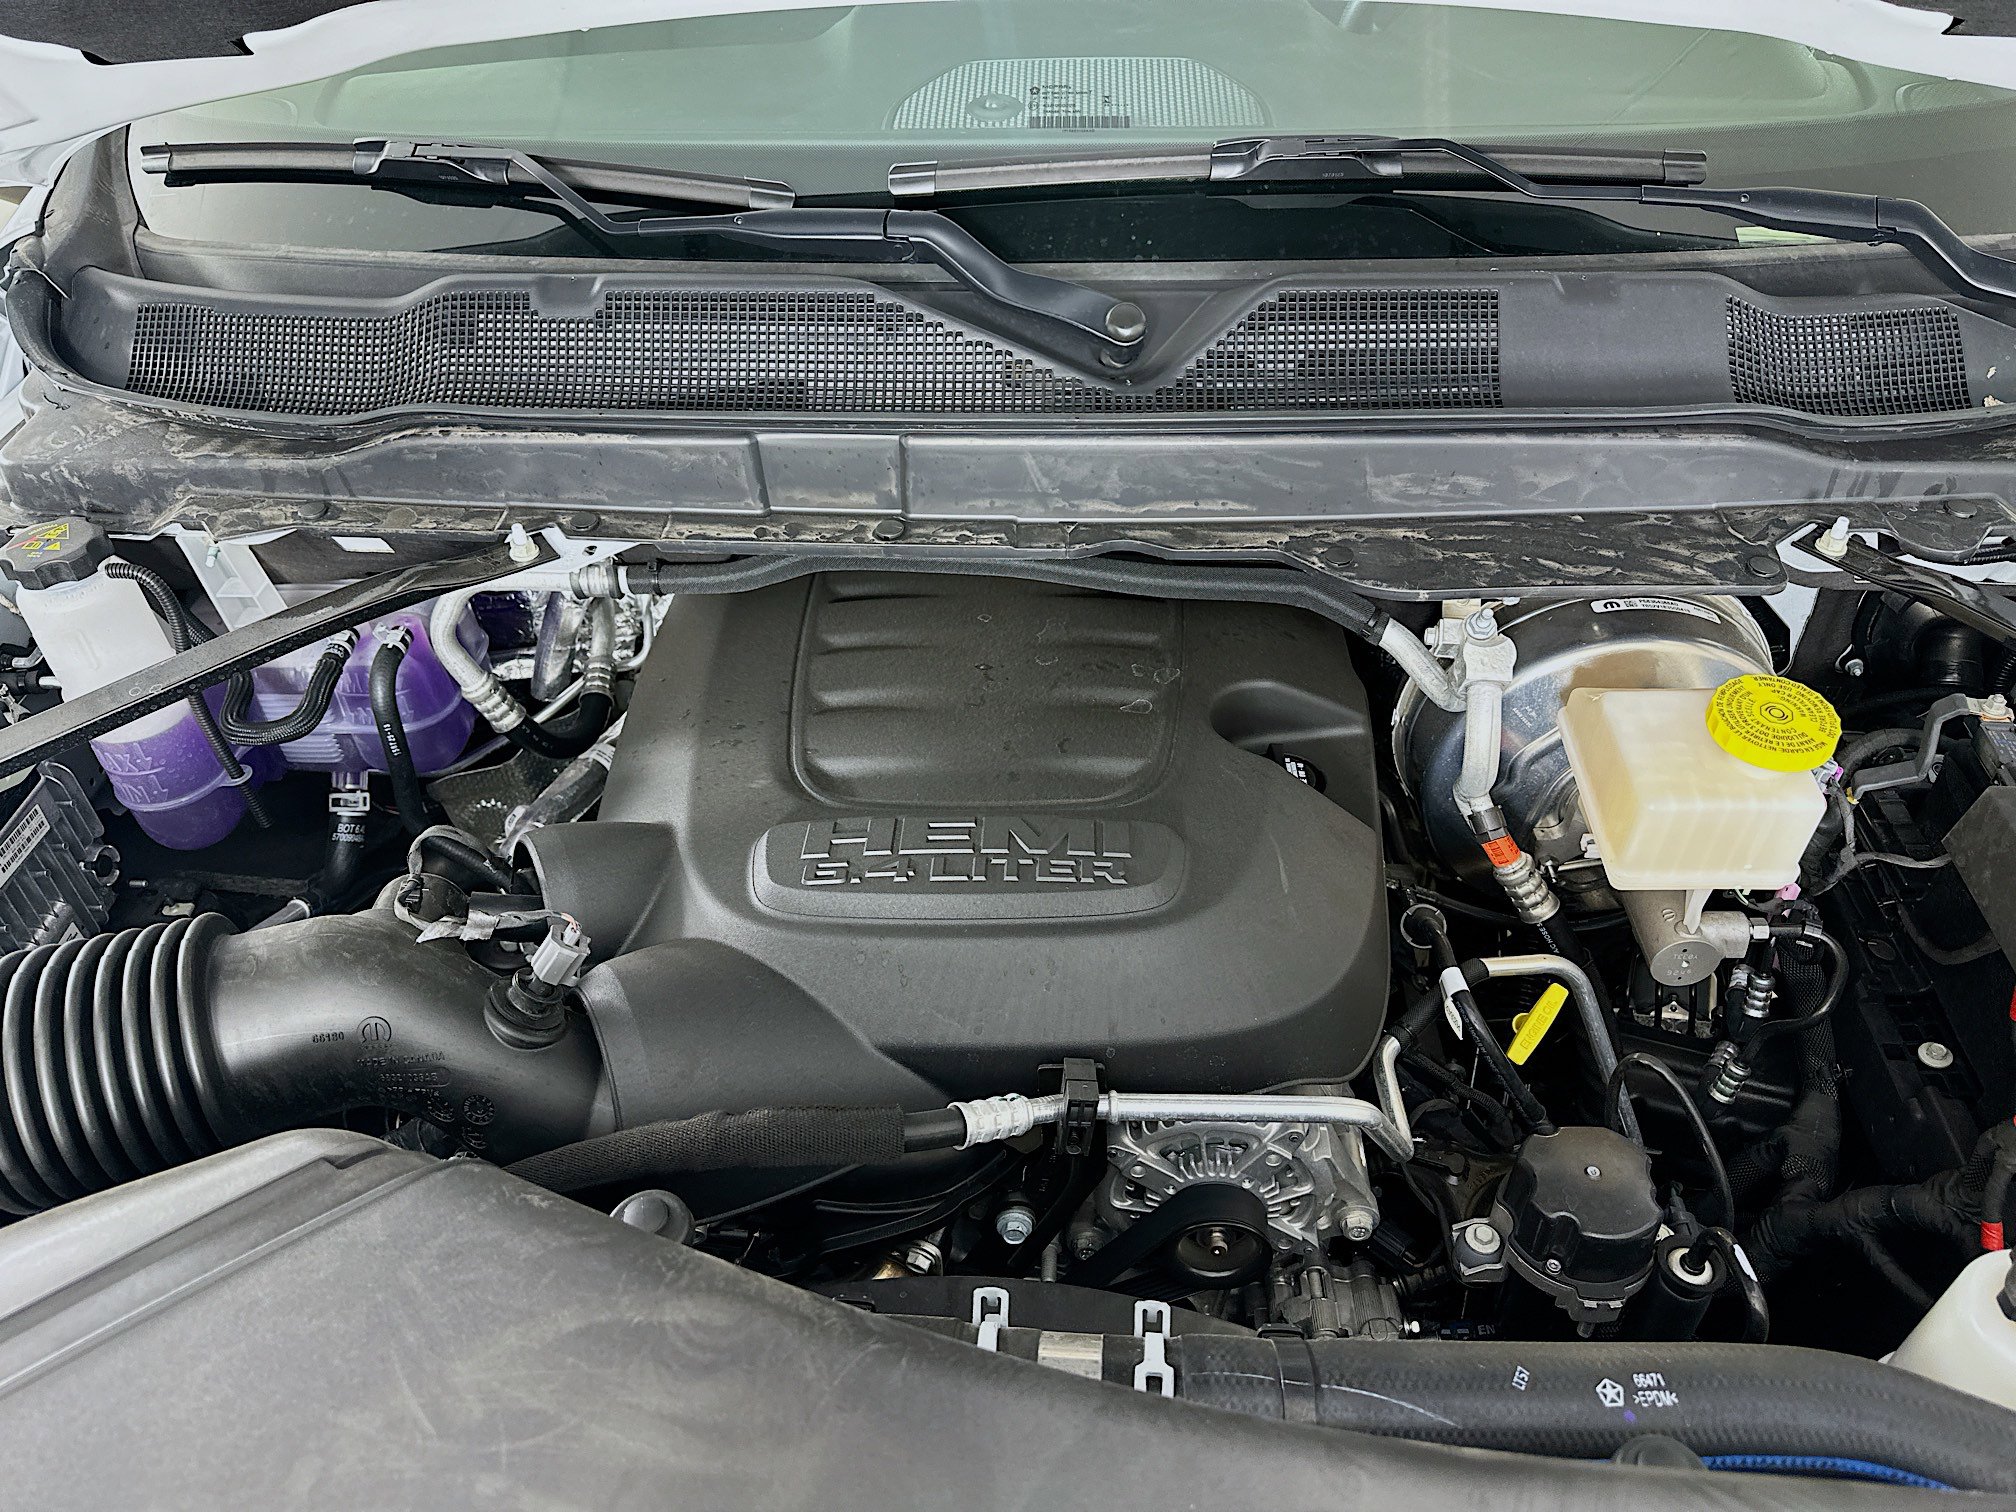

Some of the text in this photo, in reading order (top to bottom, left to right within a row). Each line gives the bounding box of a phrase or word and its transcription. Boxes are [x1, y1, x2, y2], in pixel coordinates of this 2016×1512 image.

[337, 823, 356, 834] BOT
[800, 816, 1132, 859] HEMI
[801, 856, 1128, 886] 6.4 LITER
[1538, 926, 1554, 944] HOSE
[1519, 1000, 1558, 1050] ENGINE OIL
[1632, 1372, 1666, 1388] 66471
